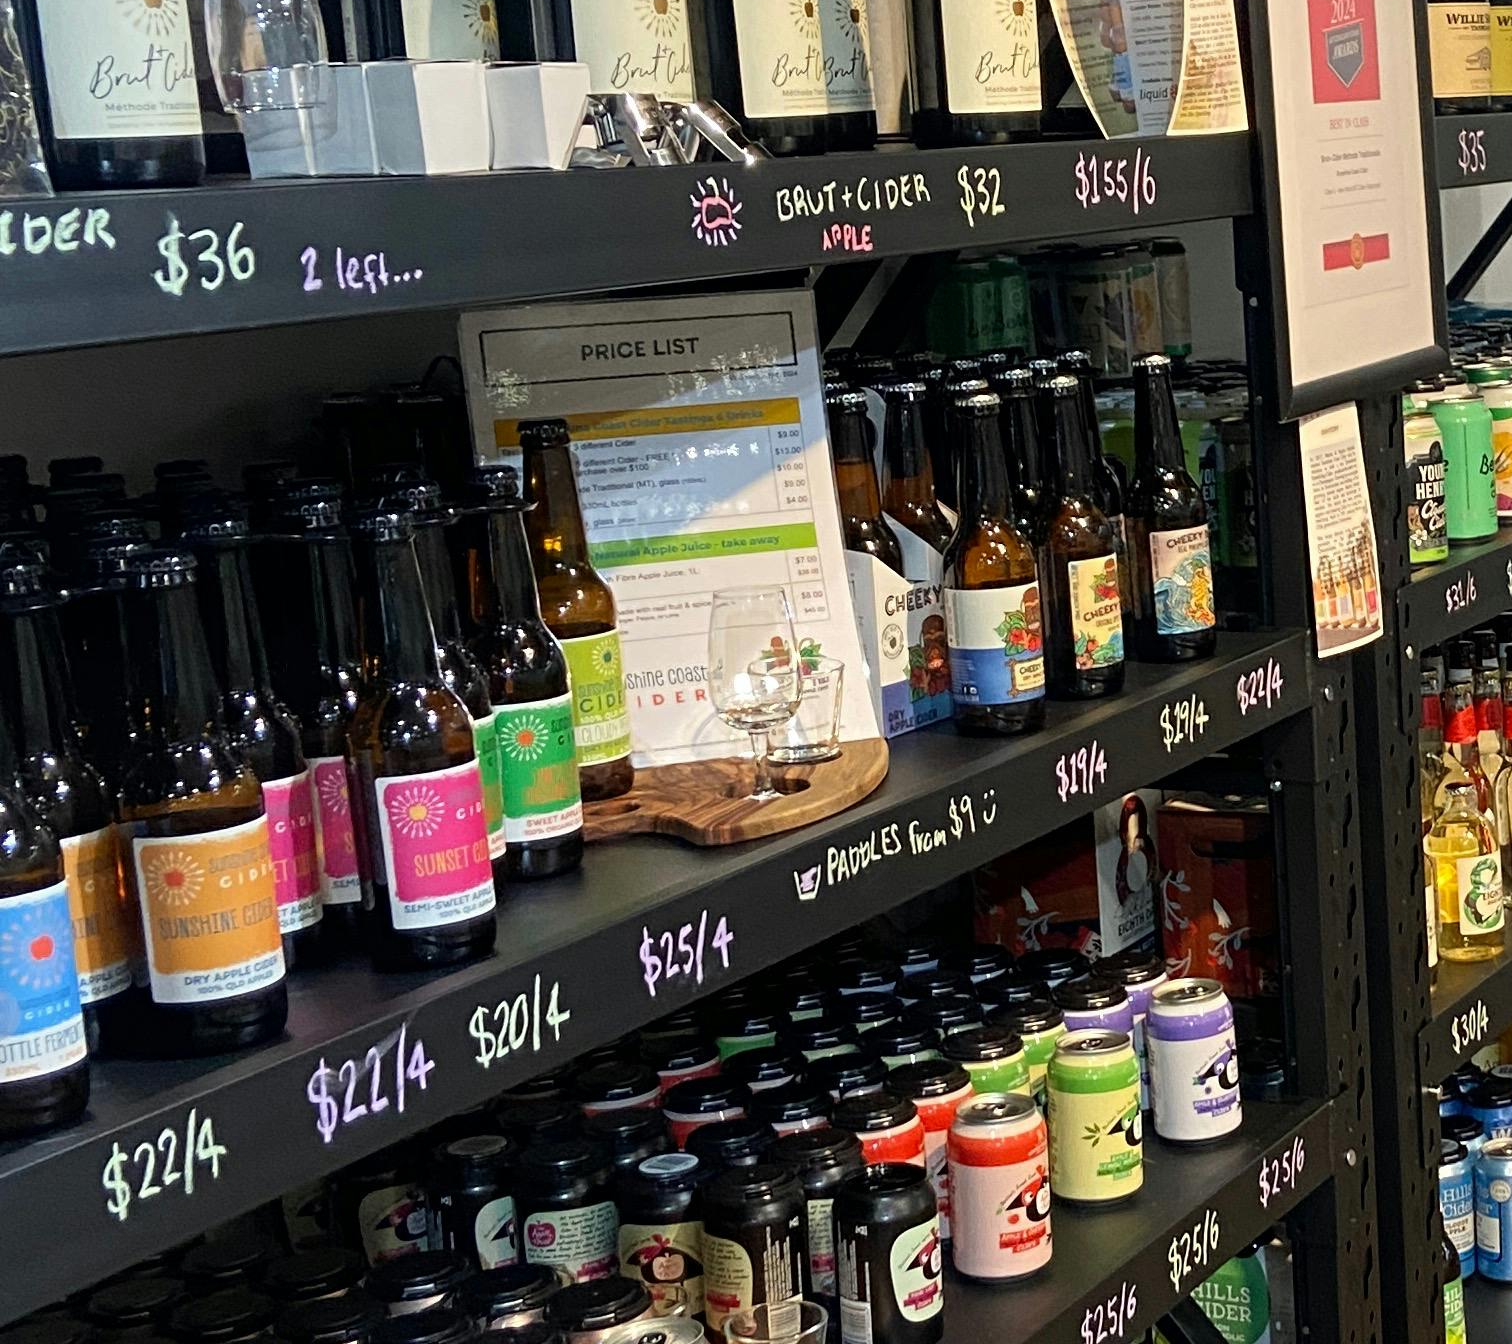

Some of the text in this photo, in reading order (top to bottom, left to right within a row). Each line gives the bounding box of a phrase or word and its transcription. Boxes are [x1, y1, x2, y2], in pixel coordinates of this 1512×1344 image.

[1458, 127, 1488, 176] $35
[957, 164, 1006, 228] $32
[1074, 147, 1156, 215] $155/6
[150, 212, 256, 297] $36
[820, 223, 874, 252] APPLE
[300, 246, 323, 292] 2
[580, 336, 700, 362] PRICE LIST
[643, 543, 679, 558] Apple
[680, 541, 713, 555] Juice
[721, 536, 747, 549] take
[749, 535, 780, 548] away
[1166, 531, 1204, 549] CHEEKY
[884, 583, 942, 617] CHEEKY
[1083, 603, 1121, 623] CHEEKY
[1446, 570, 1477, 614] $31/6
[667, 665, 709, 687] coast
[1236, 658, 1284, 716] $22/4
[1160, 692, 1210, 752] $19/4
[1055, 740, 1108, 803] $19/4
[526, 815, 559, 827] SWEET
[949, 790, 978, 839] $9
[414, 846, 470, 878] SUNSET
[158, 907, 240, 941] SUNSHINE
[404, 893, 471, 914] SEMI-SWEET
[184, 972, 211, 987] DRY
[214, 963, 251, 982] APPLE
[639, 909, 735, 998] $25/4
[467, 973, 572, 1070] $20/4
[1450, 999, 1490, 1055] $30/4
[306, 1022, 436, 1145] $22/4
[102, 1108, 228, 1223] $22/4
[1258, 1136, 1306, 1208] $25/6
[1167, 1209, 1219, 1294] $25/6
